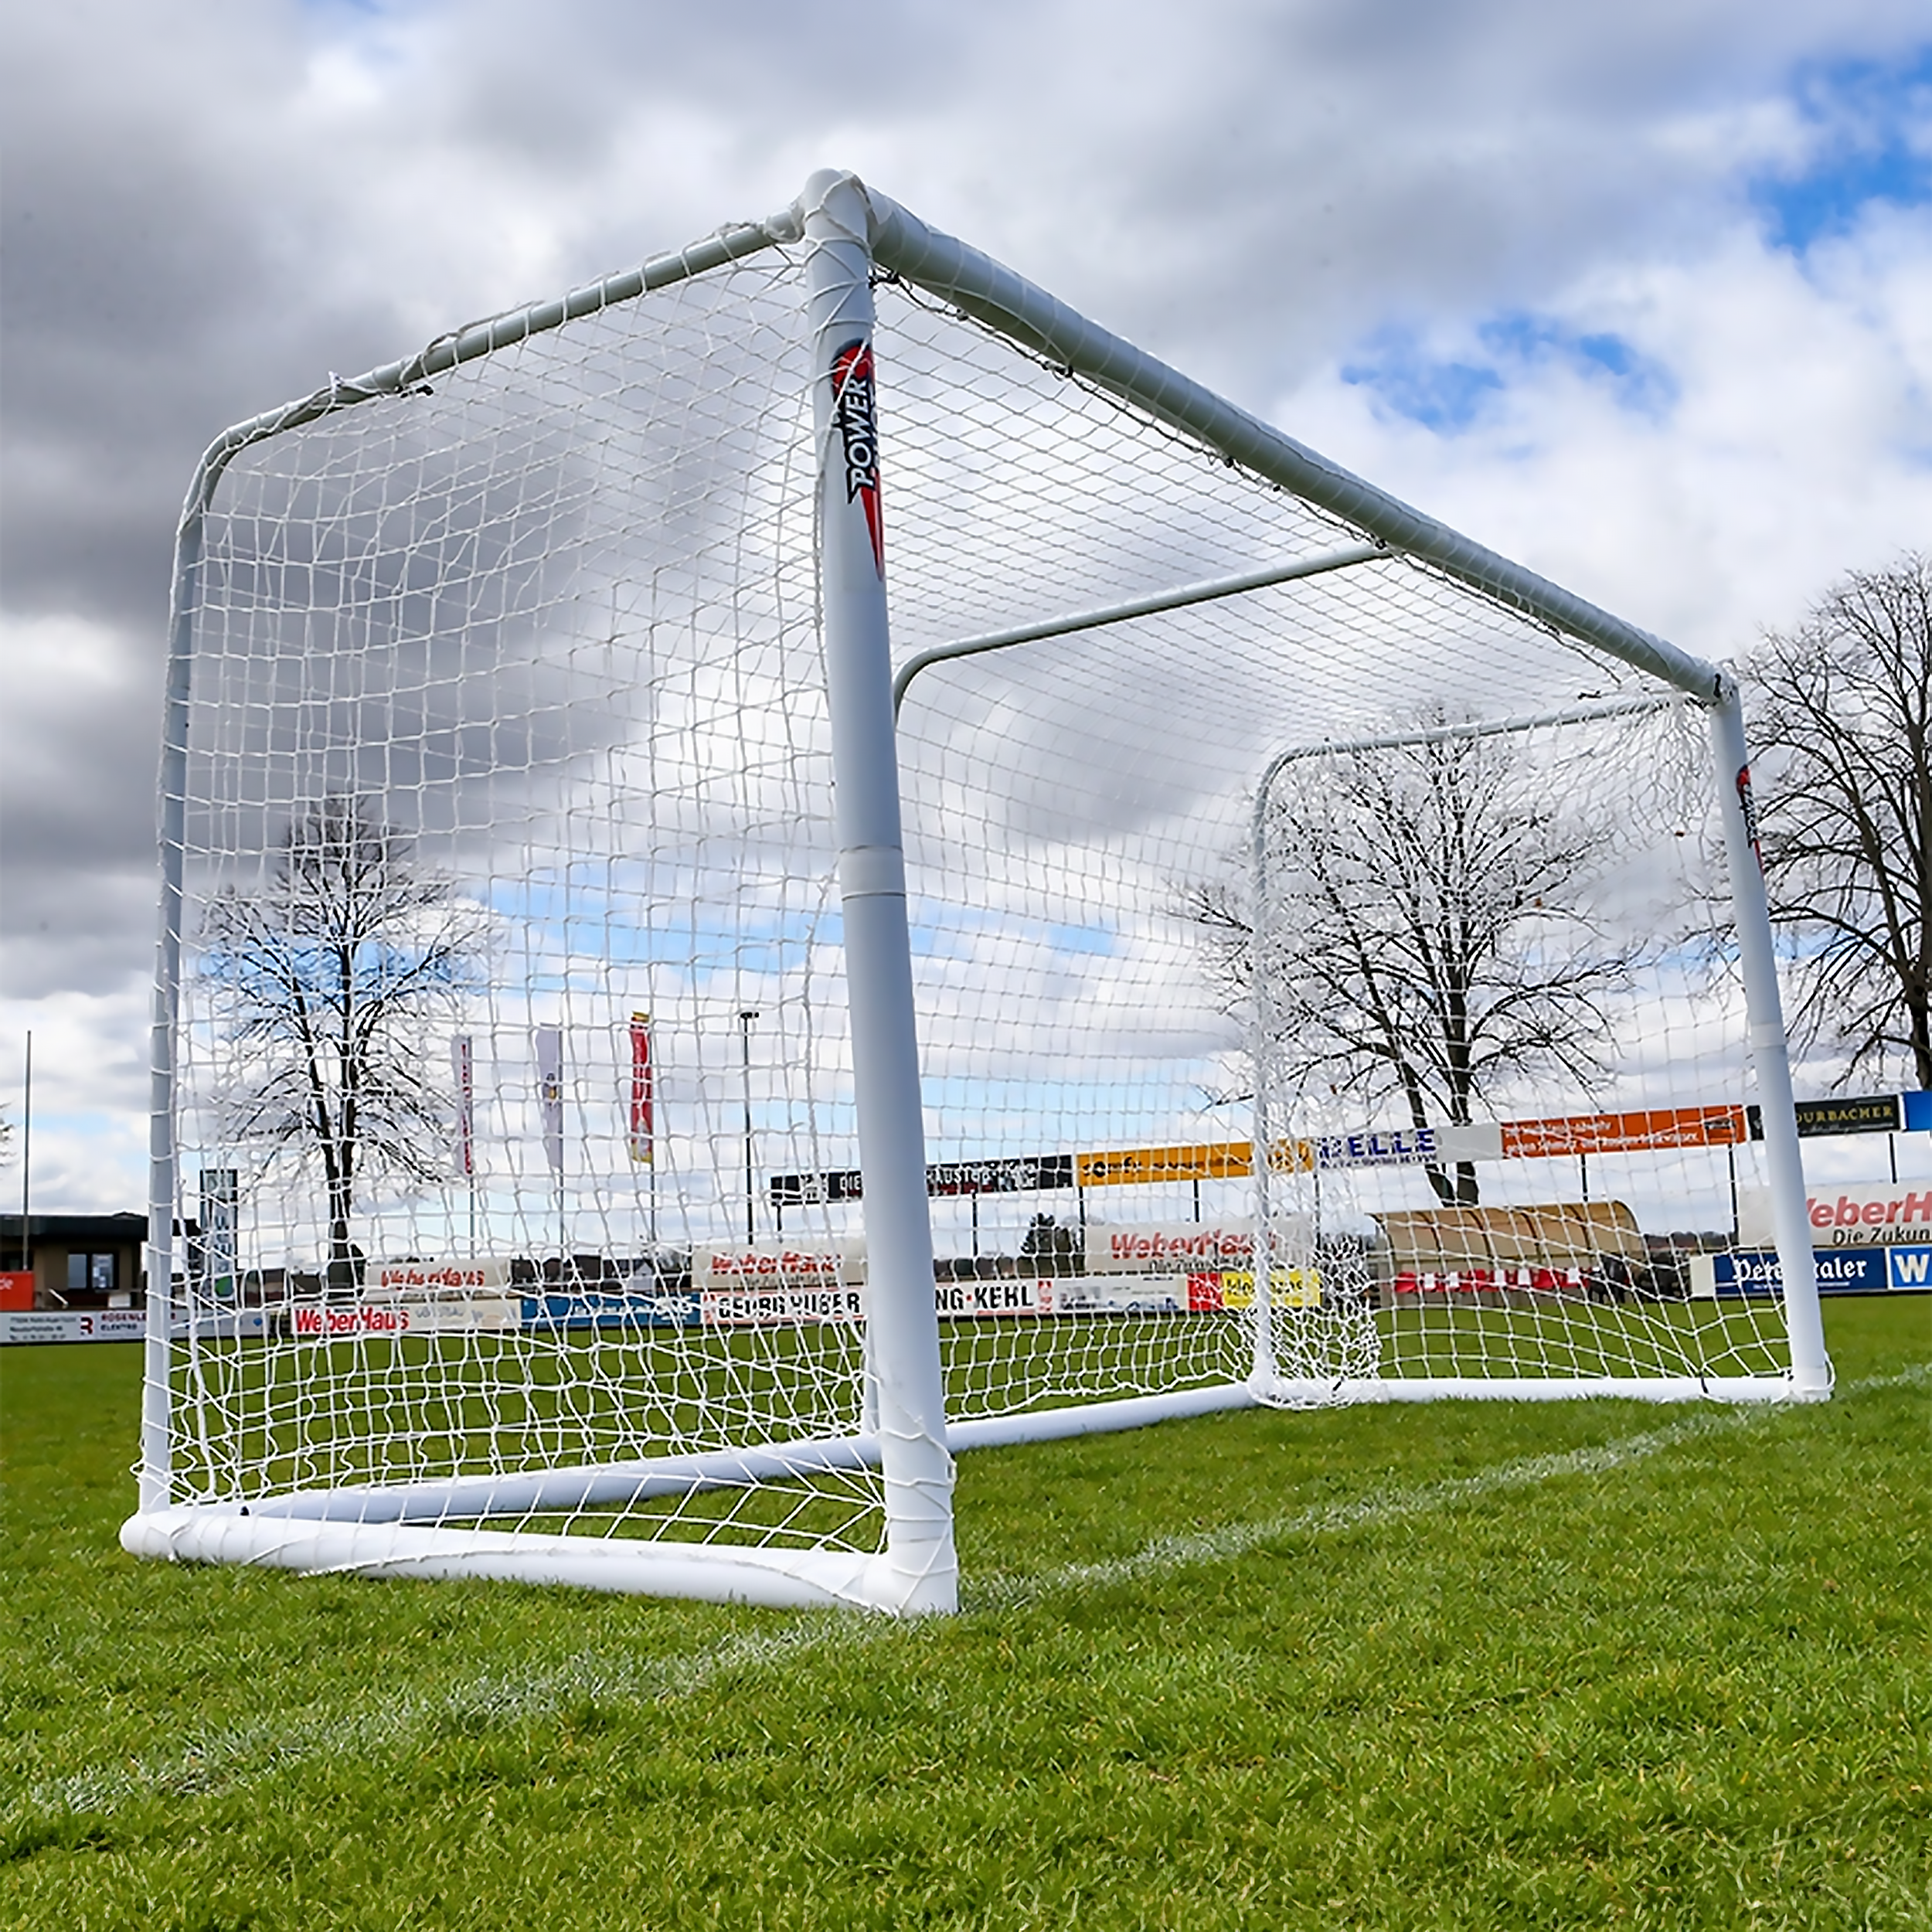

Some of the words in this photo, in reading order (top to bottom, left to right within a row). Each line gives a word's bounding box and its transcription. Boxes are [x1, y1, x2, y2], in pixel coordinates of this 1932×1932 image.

[845, 377, 875, 493] POWER
[1807, 1191, 1932, 1227] eberH
[1832, 1229, 1863, 1245] Die
[297, 1306, 410, 1332] WeberHaus
